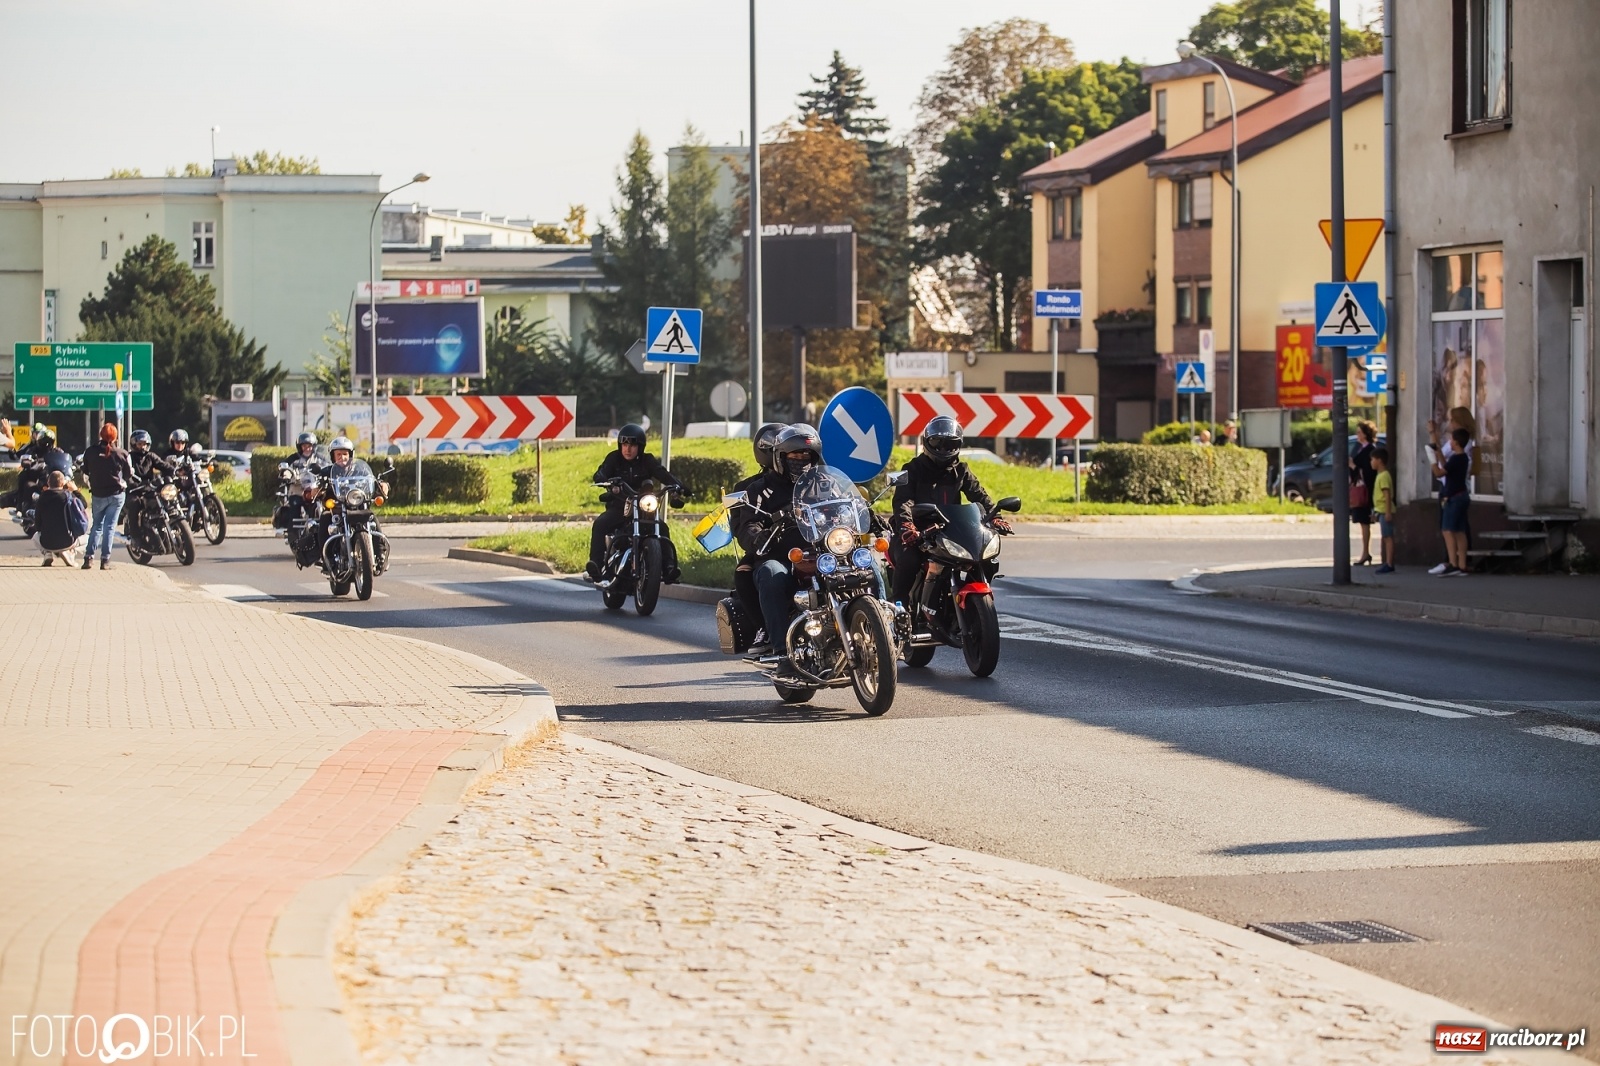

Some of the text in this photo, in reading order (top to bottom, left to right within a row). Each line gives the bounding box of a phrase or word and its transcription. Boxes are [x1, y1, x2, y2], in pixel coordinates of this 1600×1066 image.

[426, 281, 462, 295] 8 min
[1046, 294, 1071, 304] Rondo
[55, 346, 87, 355] Rybnik
[55, 357, 90, 367] Gliwice
[36, 396, 84, 407] 45 Opole
